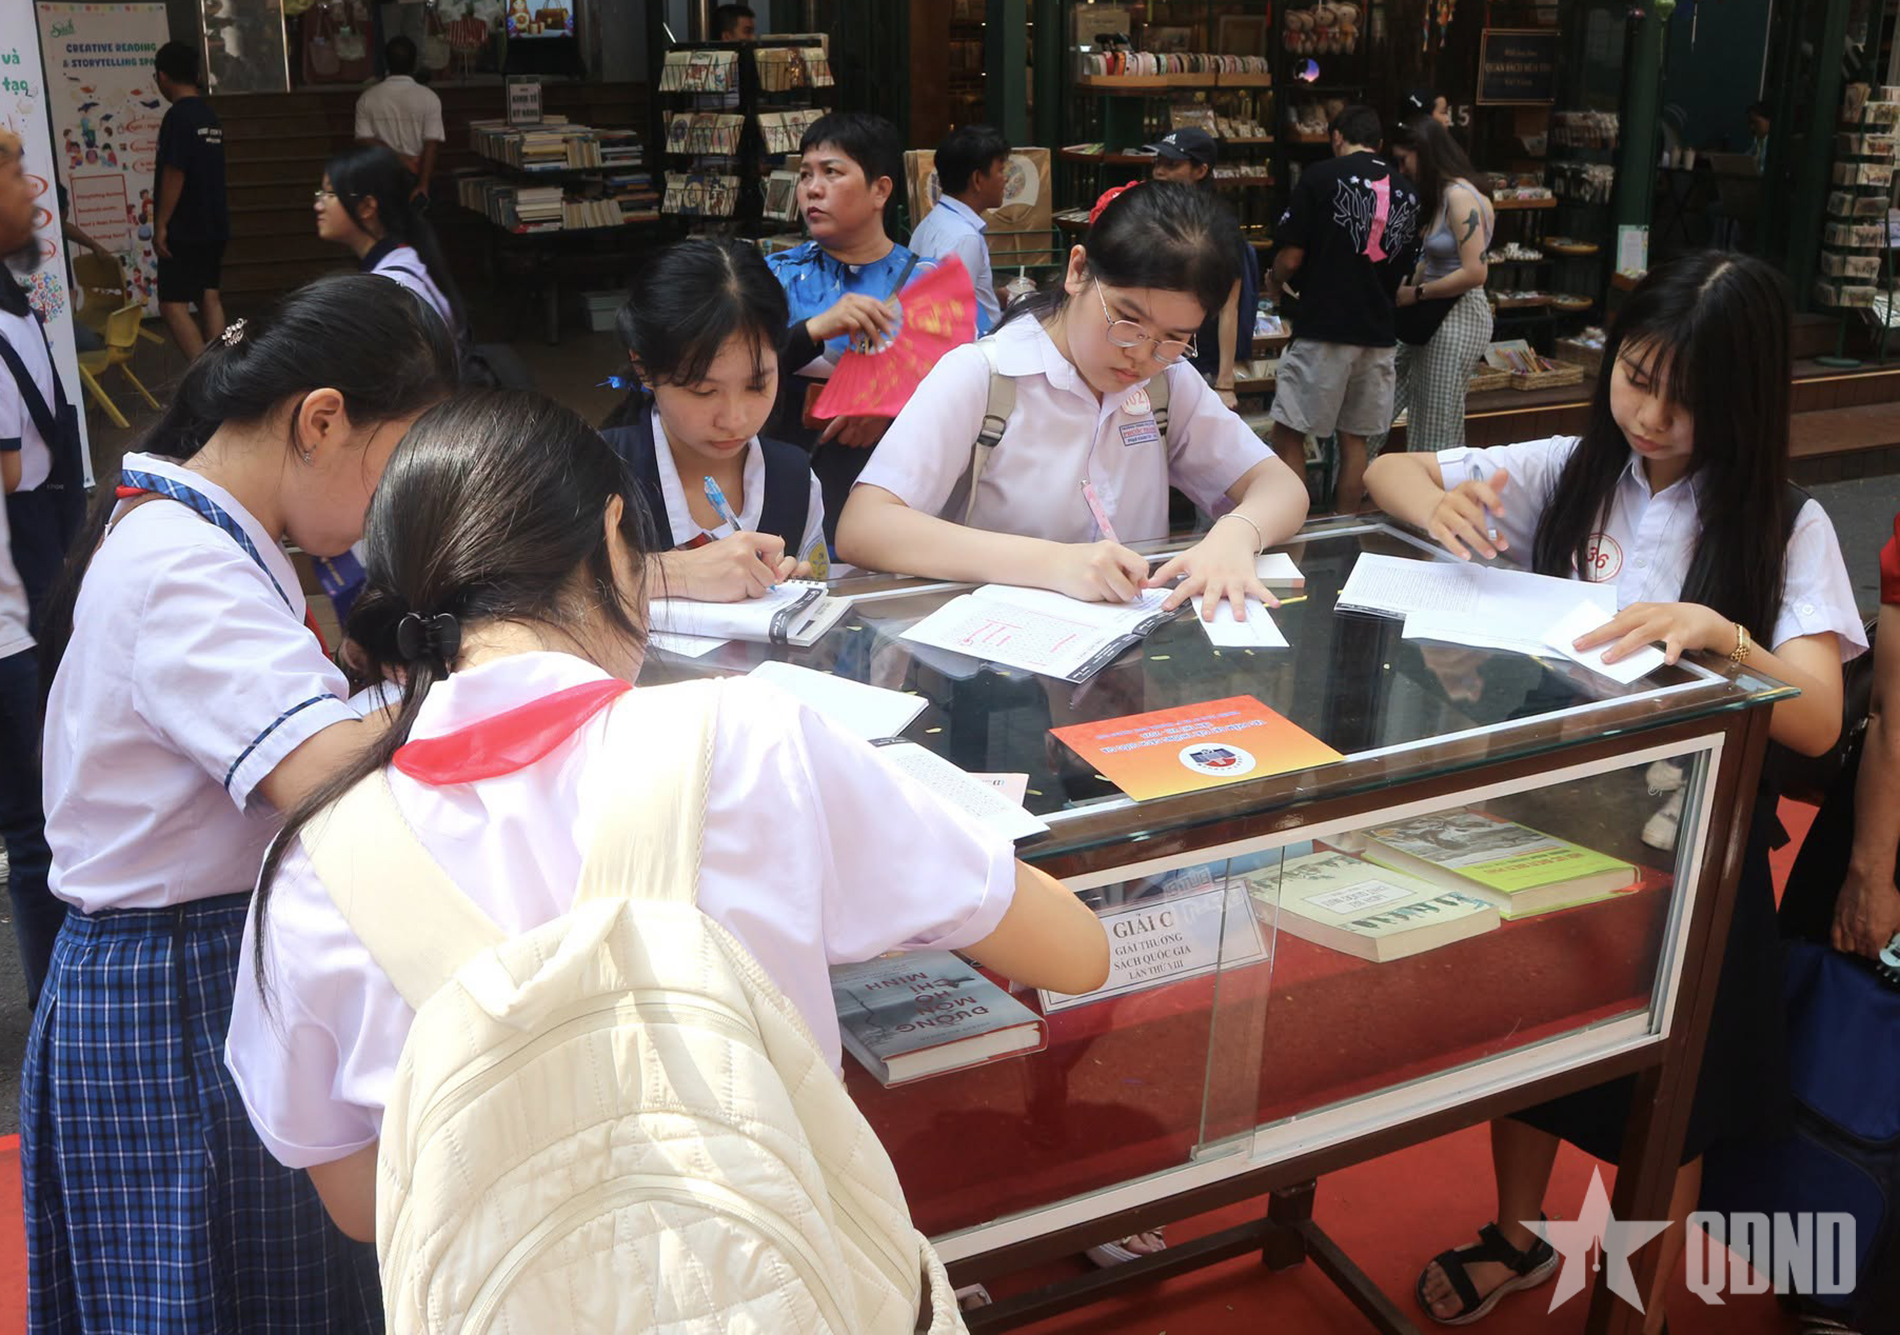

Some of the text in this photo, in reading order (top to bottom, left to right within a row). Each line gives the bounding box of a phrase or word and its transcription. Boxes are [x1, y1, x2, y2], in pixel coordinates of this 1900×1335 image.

[2, 49, 20, 65] và
[66, 43, 157, 53] CREATIVE READING
[71, 58, 137, 68] STORYTELLING
[2, 76, 28, 95] tạo
[1113, 911, 1175, 939] GIẢI C
[1115, 933, 1183, 957] GIẢI THƯỞNG
[1114, 945, 1192, 971] SÁCH QUỐC GIA
[1148, 962, 1167, 975] THỨ
[1167, 960, 1184, 971] VIII
[865, 972, 928, 991] MINH
[909, 978, 951, 994] CHÍ
[915, 990, 950, 1006] HỒ
[915, 996, 977, 1016] MÒN
[895, 1006, 989, 1032] ĐƯỜNG
